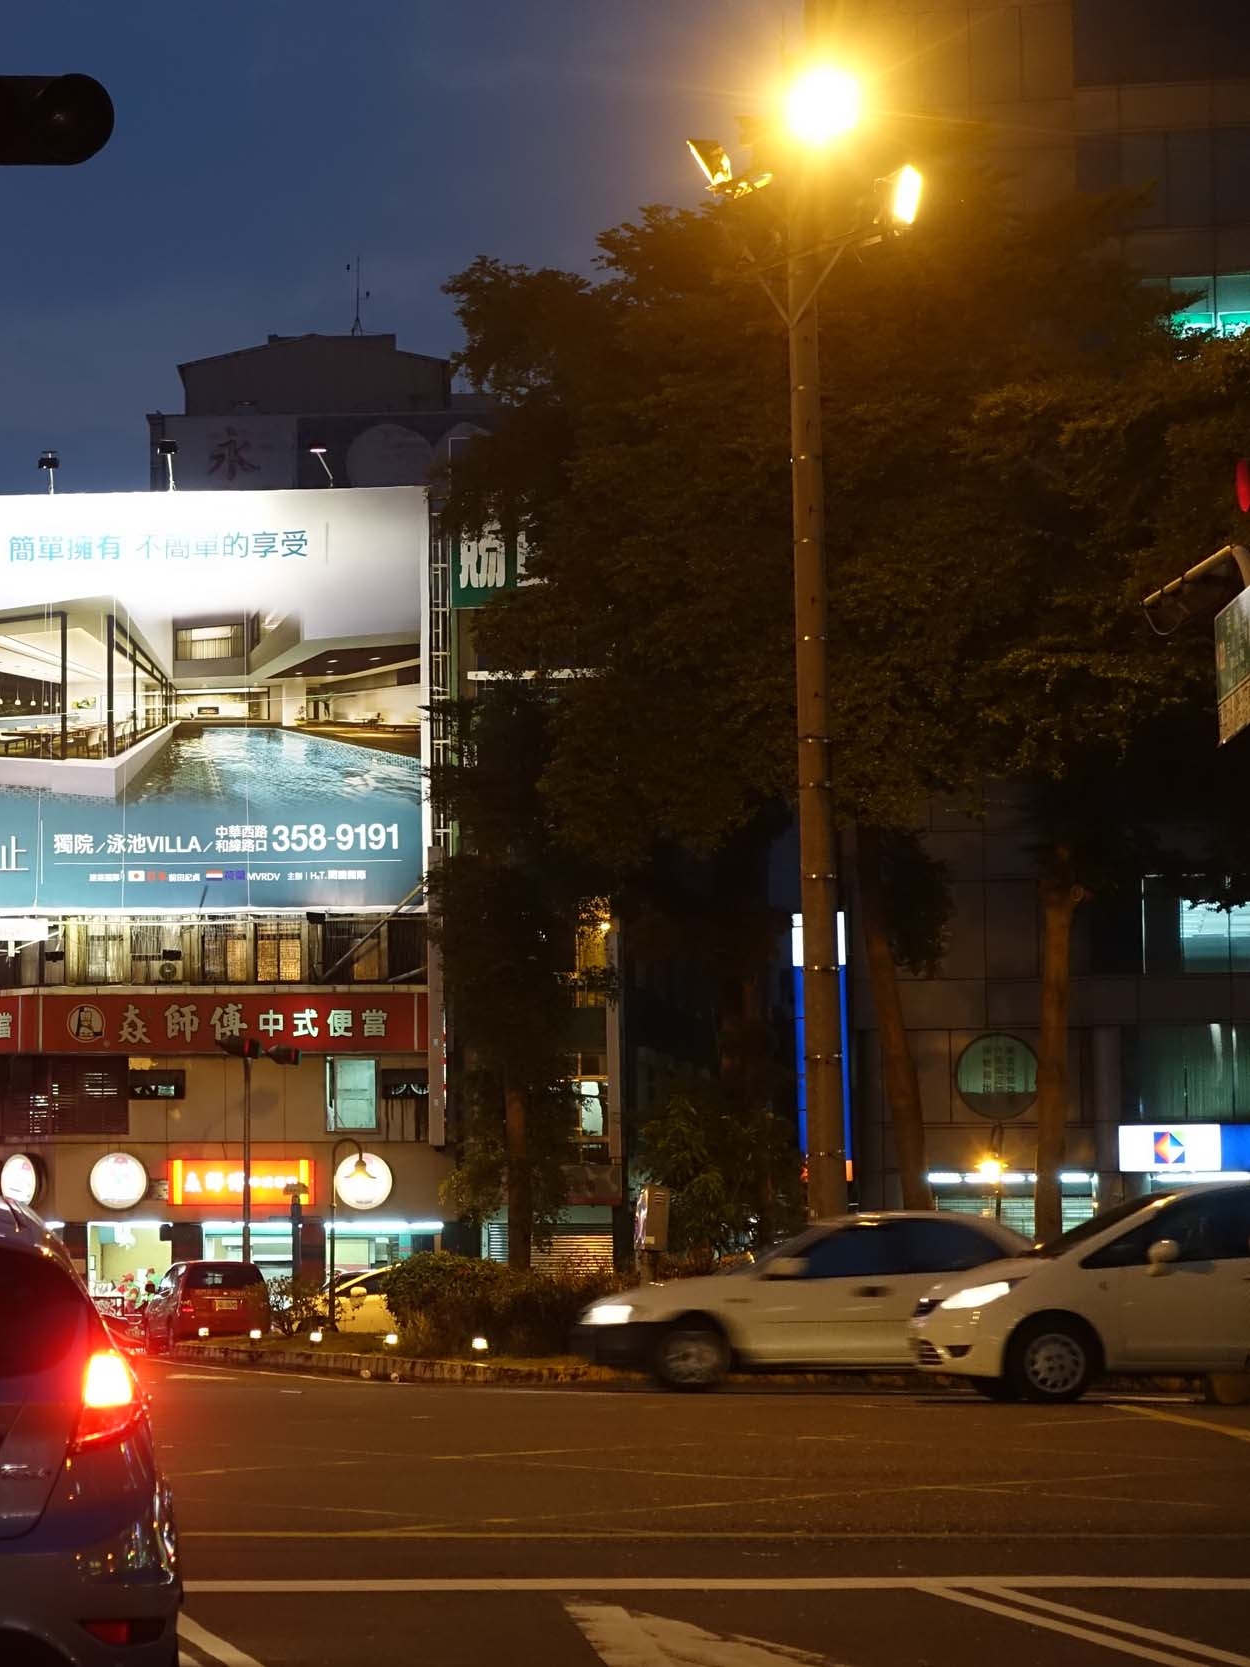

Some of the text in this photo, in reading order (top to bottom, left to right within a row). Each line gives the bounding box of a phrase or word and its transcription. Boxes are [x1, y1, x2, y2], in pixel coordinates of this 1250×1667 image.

[10, 535, 120, 562] 簡單擁有
[215, 825, 268, 839] 中華西路
[272, 823, 399, 852] 358-9191
[247, 872, 280, 881] MVRDV
